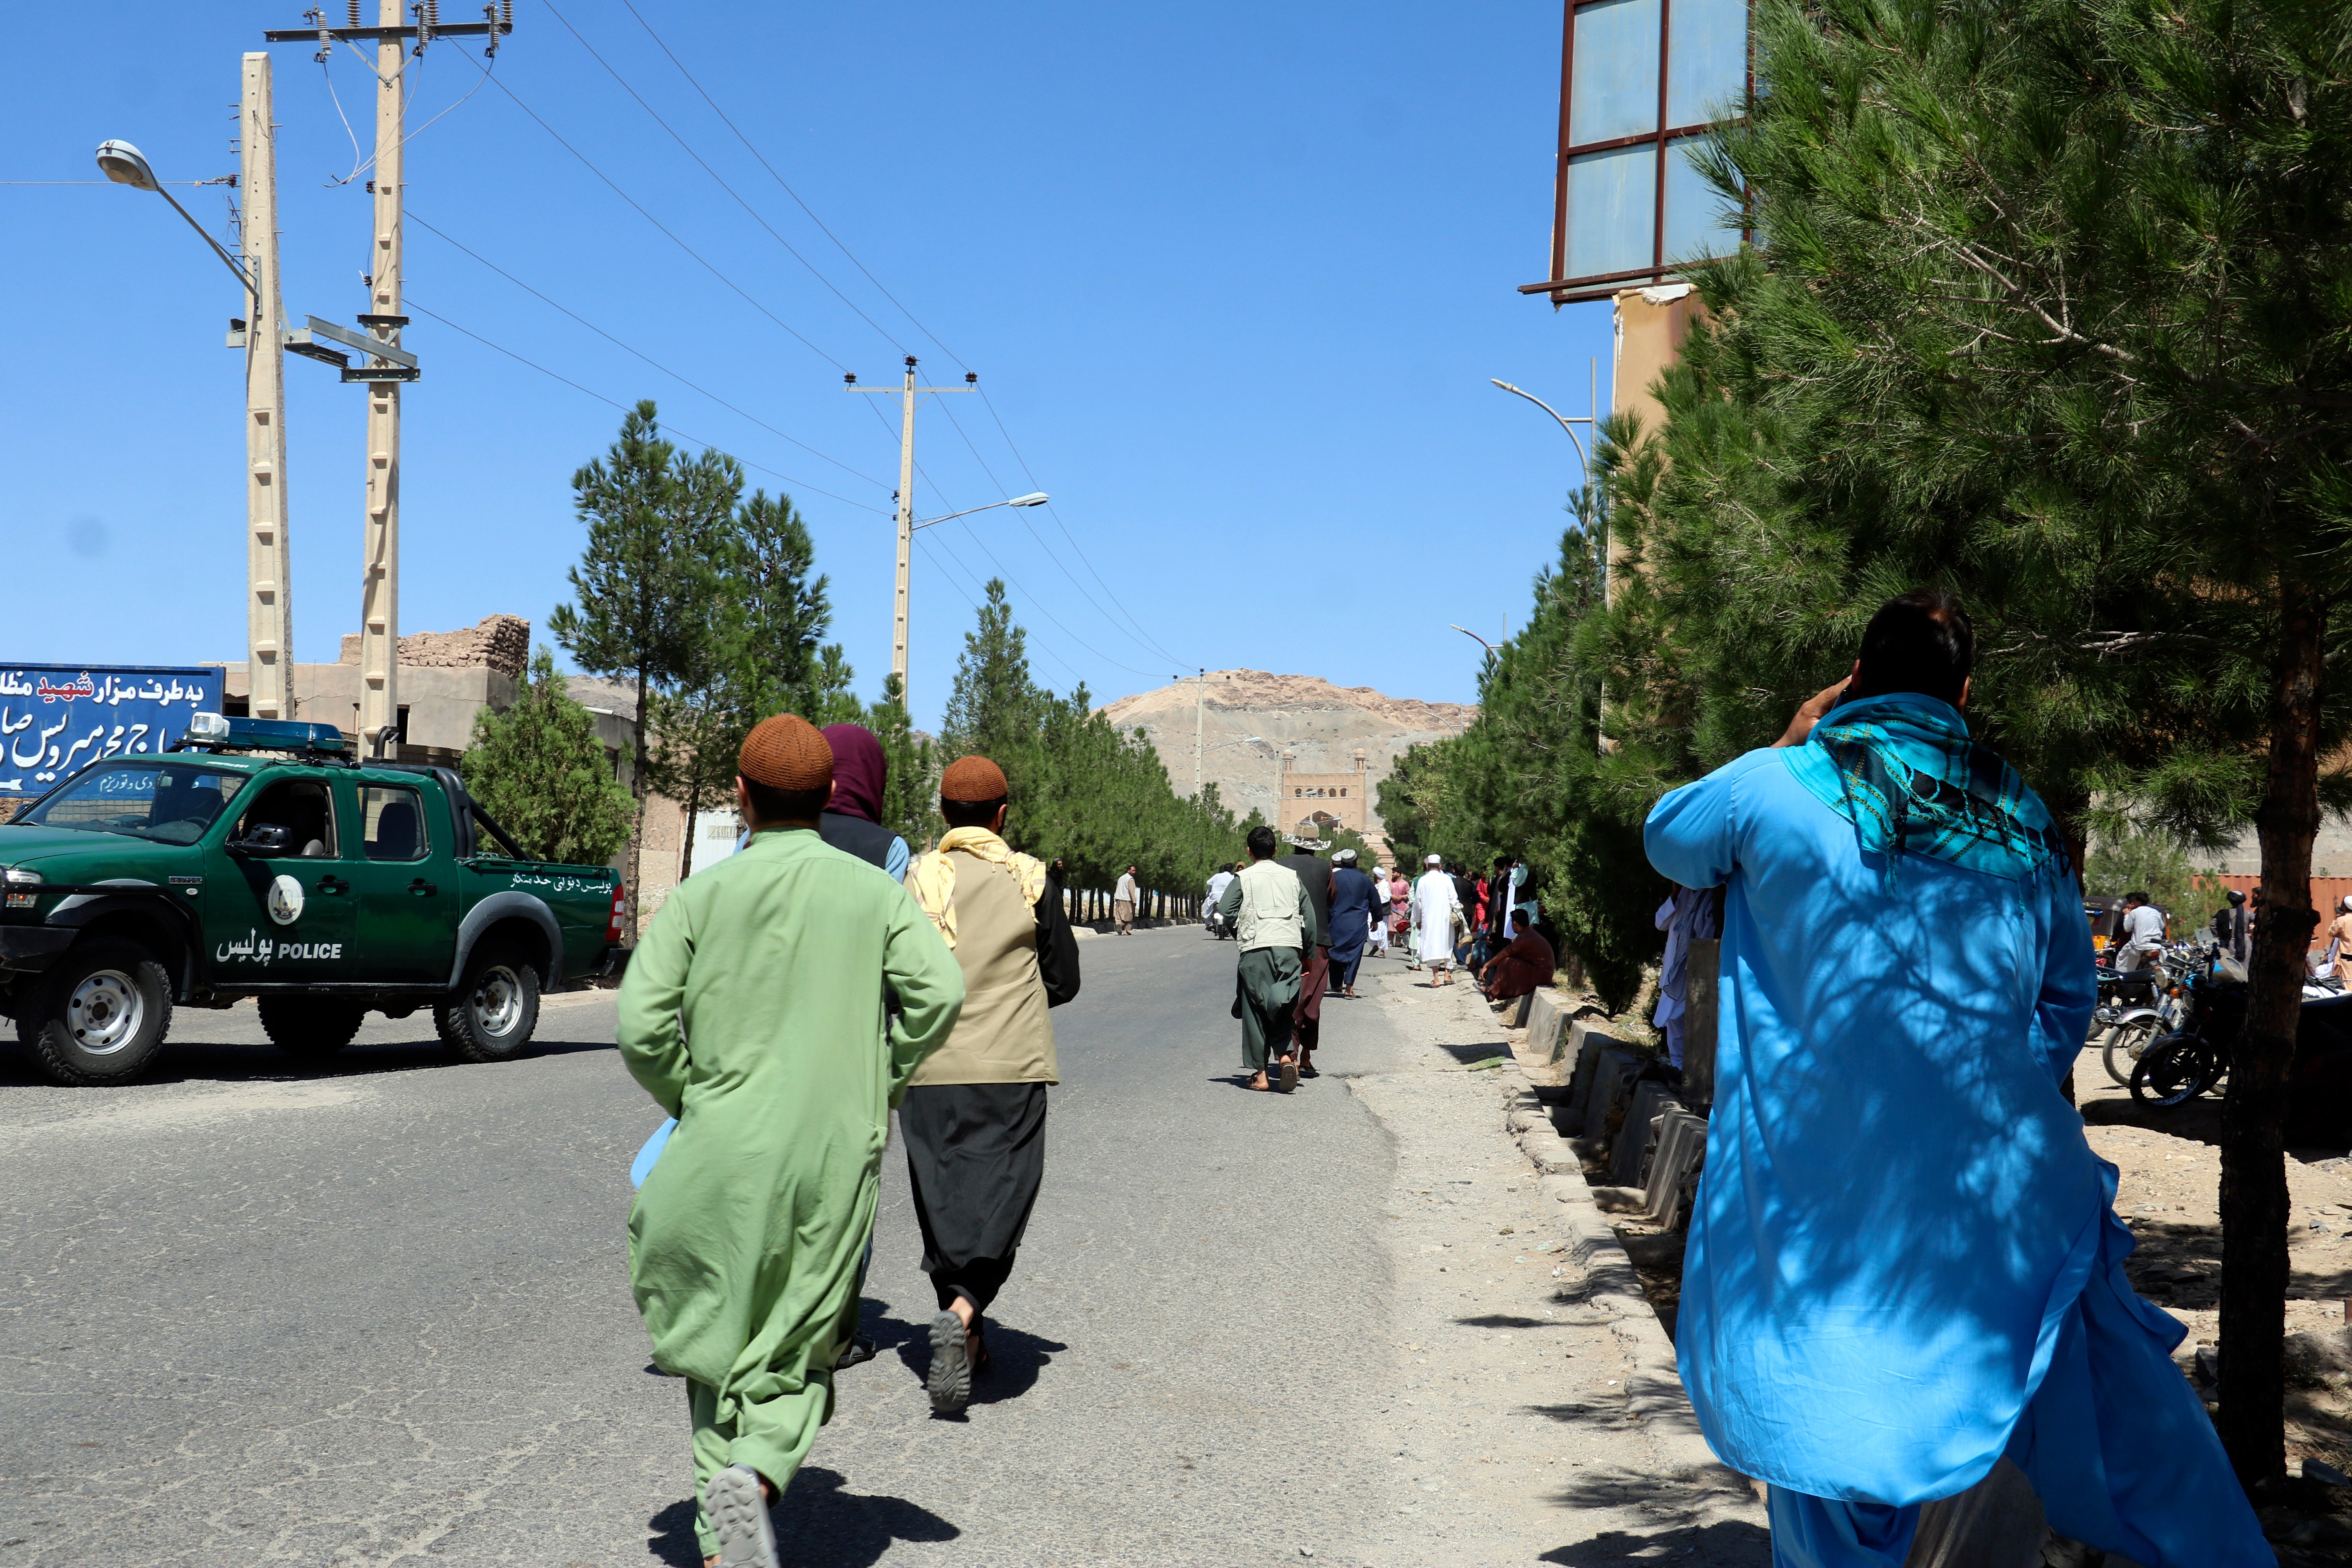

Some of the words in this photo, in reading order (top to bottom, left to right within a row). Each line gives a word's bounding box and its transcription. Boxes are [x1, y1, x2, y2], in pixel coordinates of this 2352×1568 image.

[0, 671, 33, 696] مظل
[36, 671, 94, 704] شهید
[93, 675, 136, 705] مزار
[139, 679, 183, 706] طرف
[185, 685, 204, 708] به
[83, 725, 125, 768] محد
[100, 774, 128, 793] توریزم
[581, 879, 613, 894] پولیس
[216, 927, 272, 967] پولیس
[278, 943, 342, 959] POLICE
